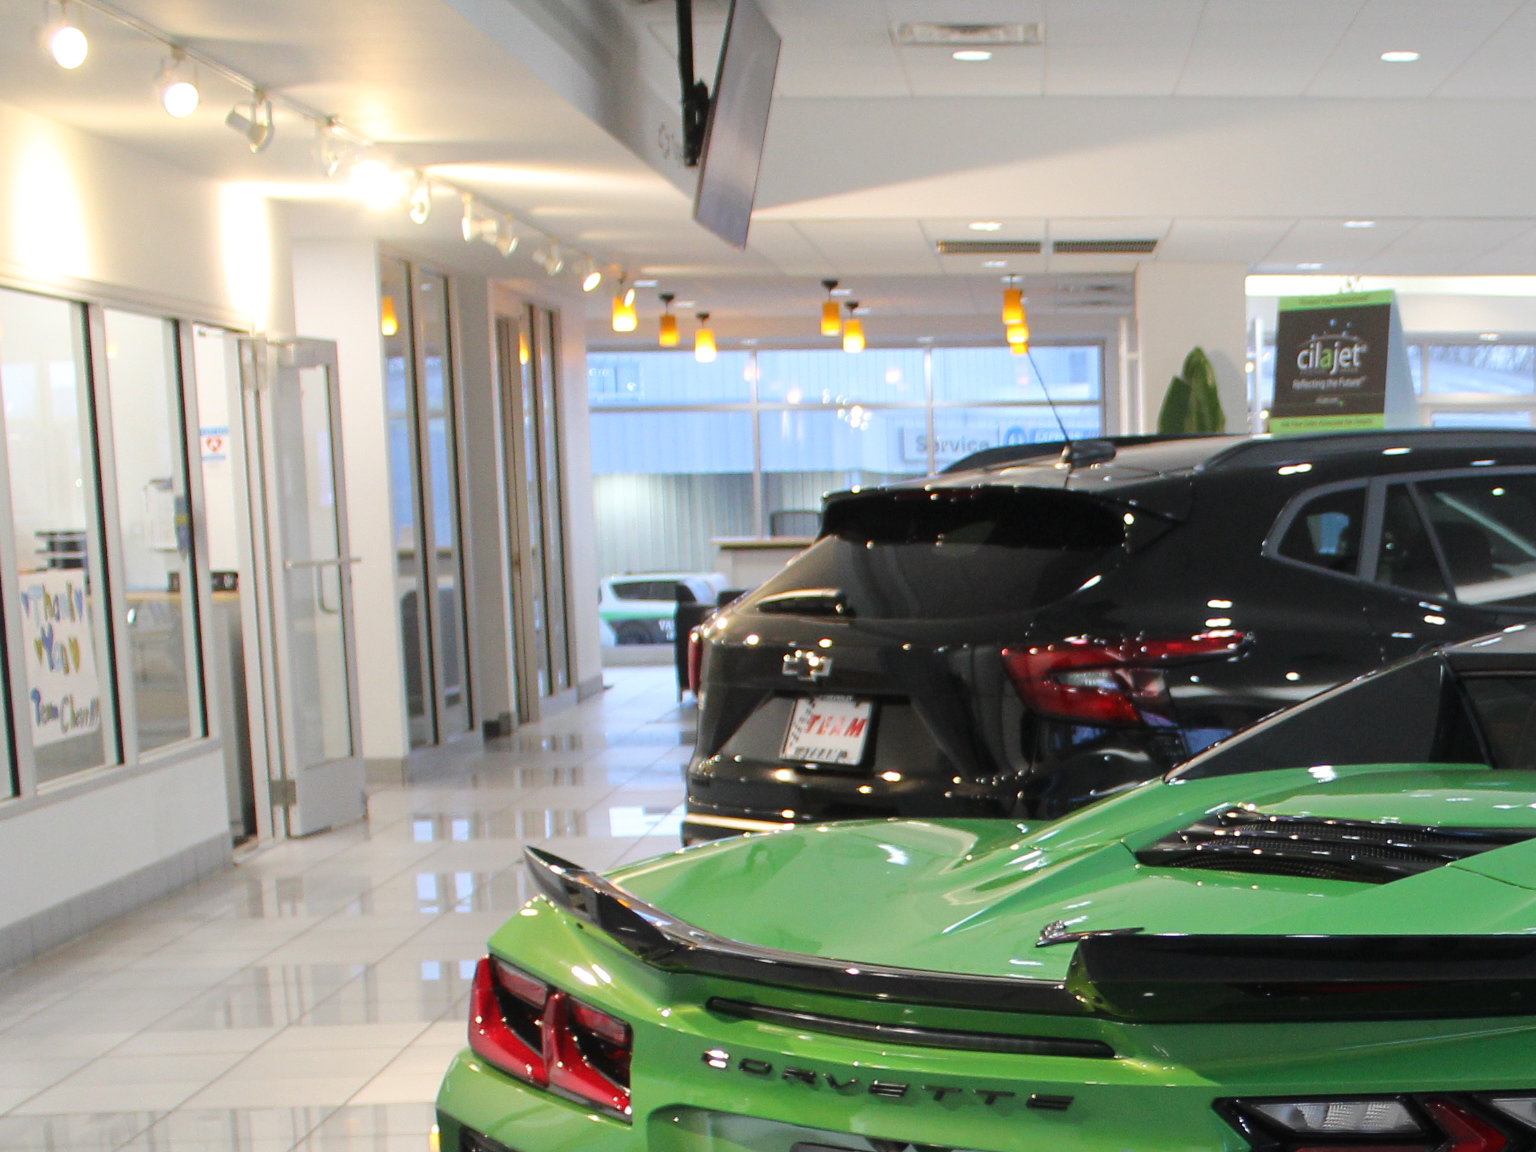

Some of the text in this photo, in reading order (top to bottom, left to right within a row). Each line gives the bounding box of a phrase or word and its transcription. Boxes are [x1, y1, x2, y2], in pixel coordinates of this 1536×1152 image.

[1297, 341, 1362, 375] cilajet
[804, 714, 868, 738] TEAM
[701, 1049, 1075, 1111] CORVETTE
